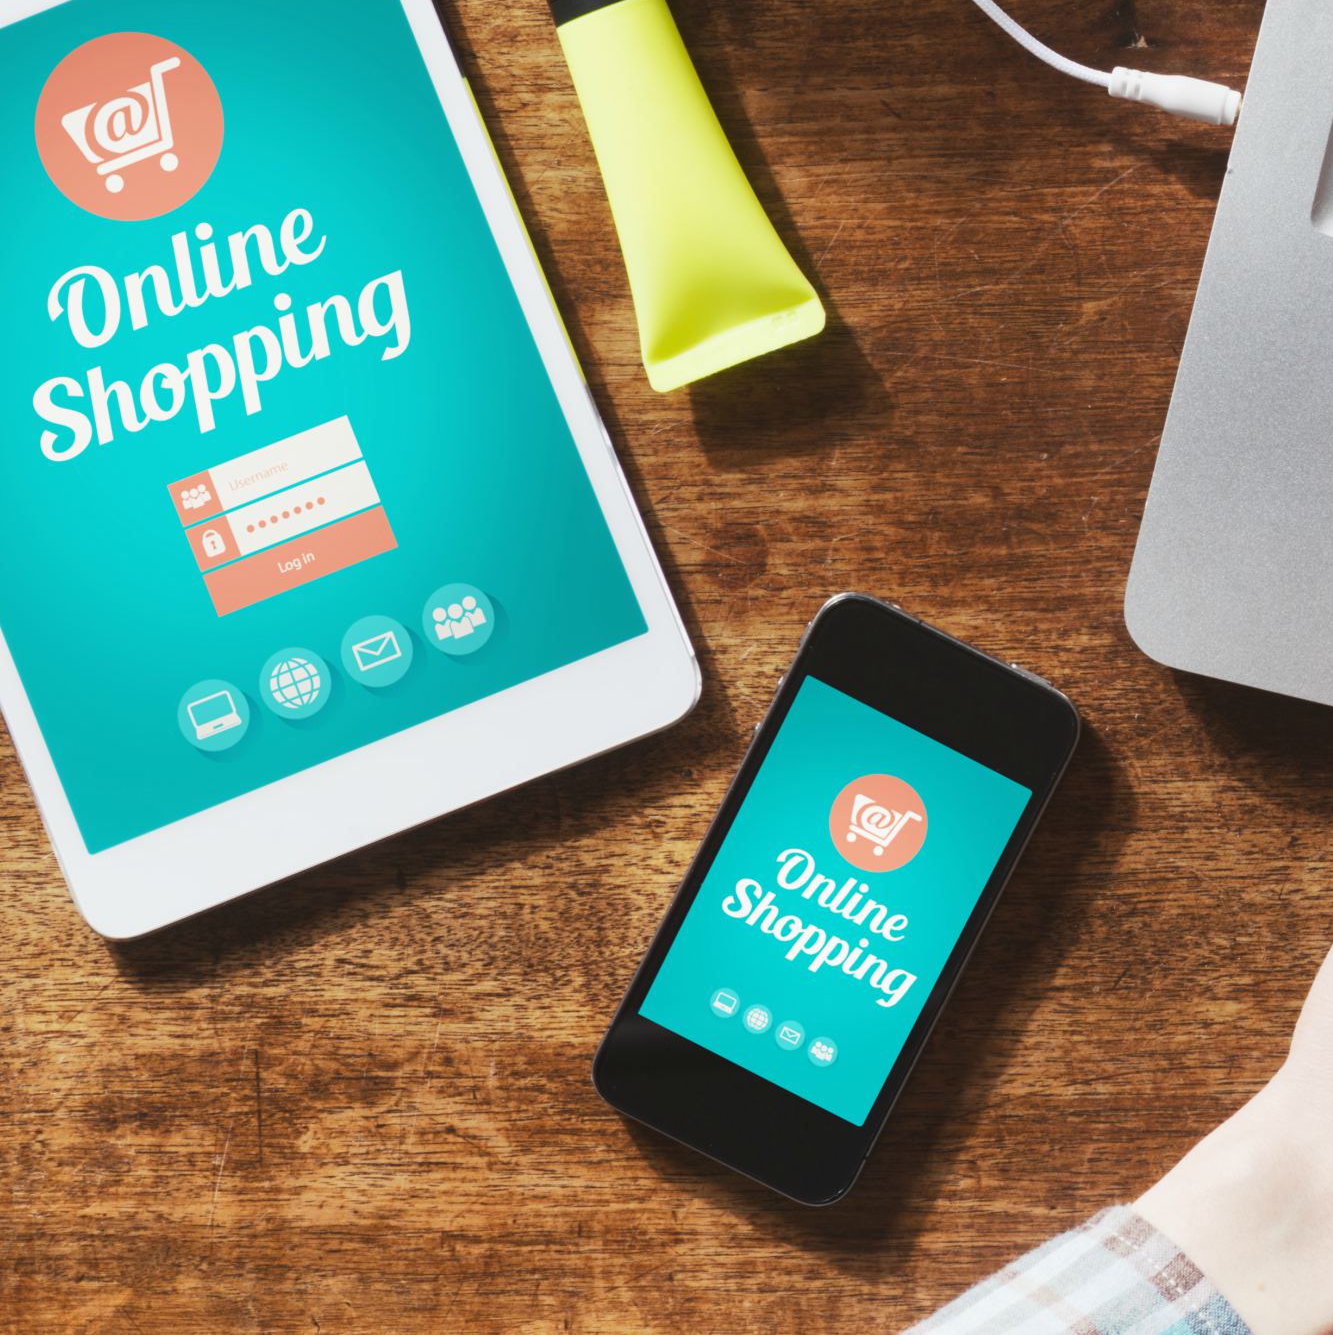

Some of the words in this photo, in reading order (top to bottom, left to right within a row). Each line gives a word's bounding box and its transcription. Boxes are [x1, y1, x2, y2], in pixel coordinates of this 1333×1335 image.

[47, 208, 327, 348] Online
[32, 269, 411, 462] Shopping
[228, 462, 289, 491] Username
[278, 558, 302, 573] Log
[302, 552, 316, 564] in
[721, 878, 918, 1008] Shopping
[776, 848, 909, 942] Online
